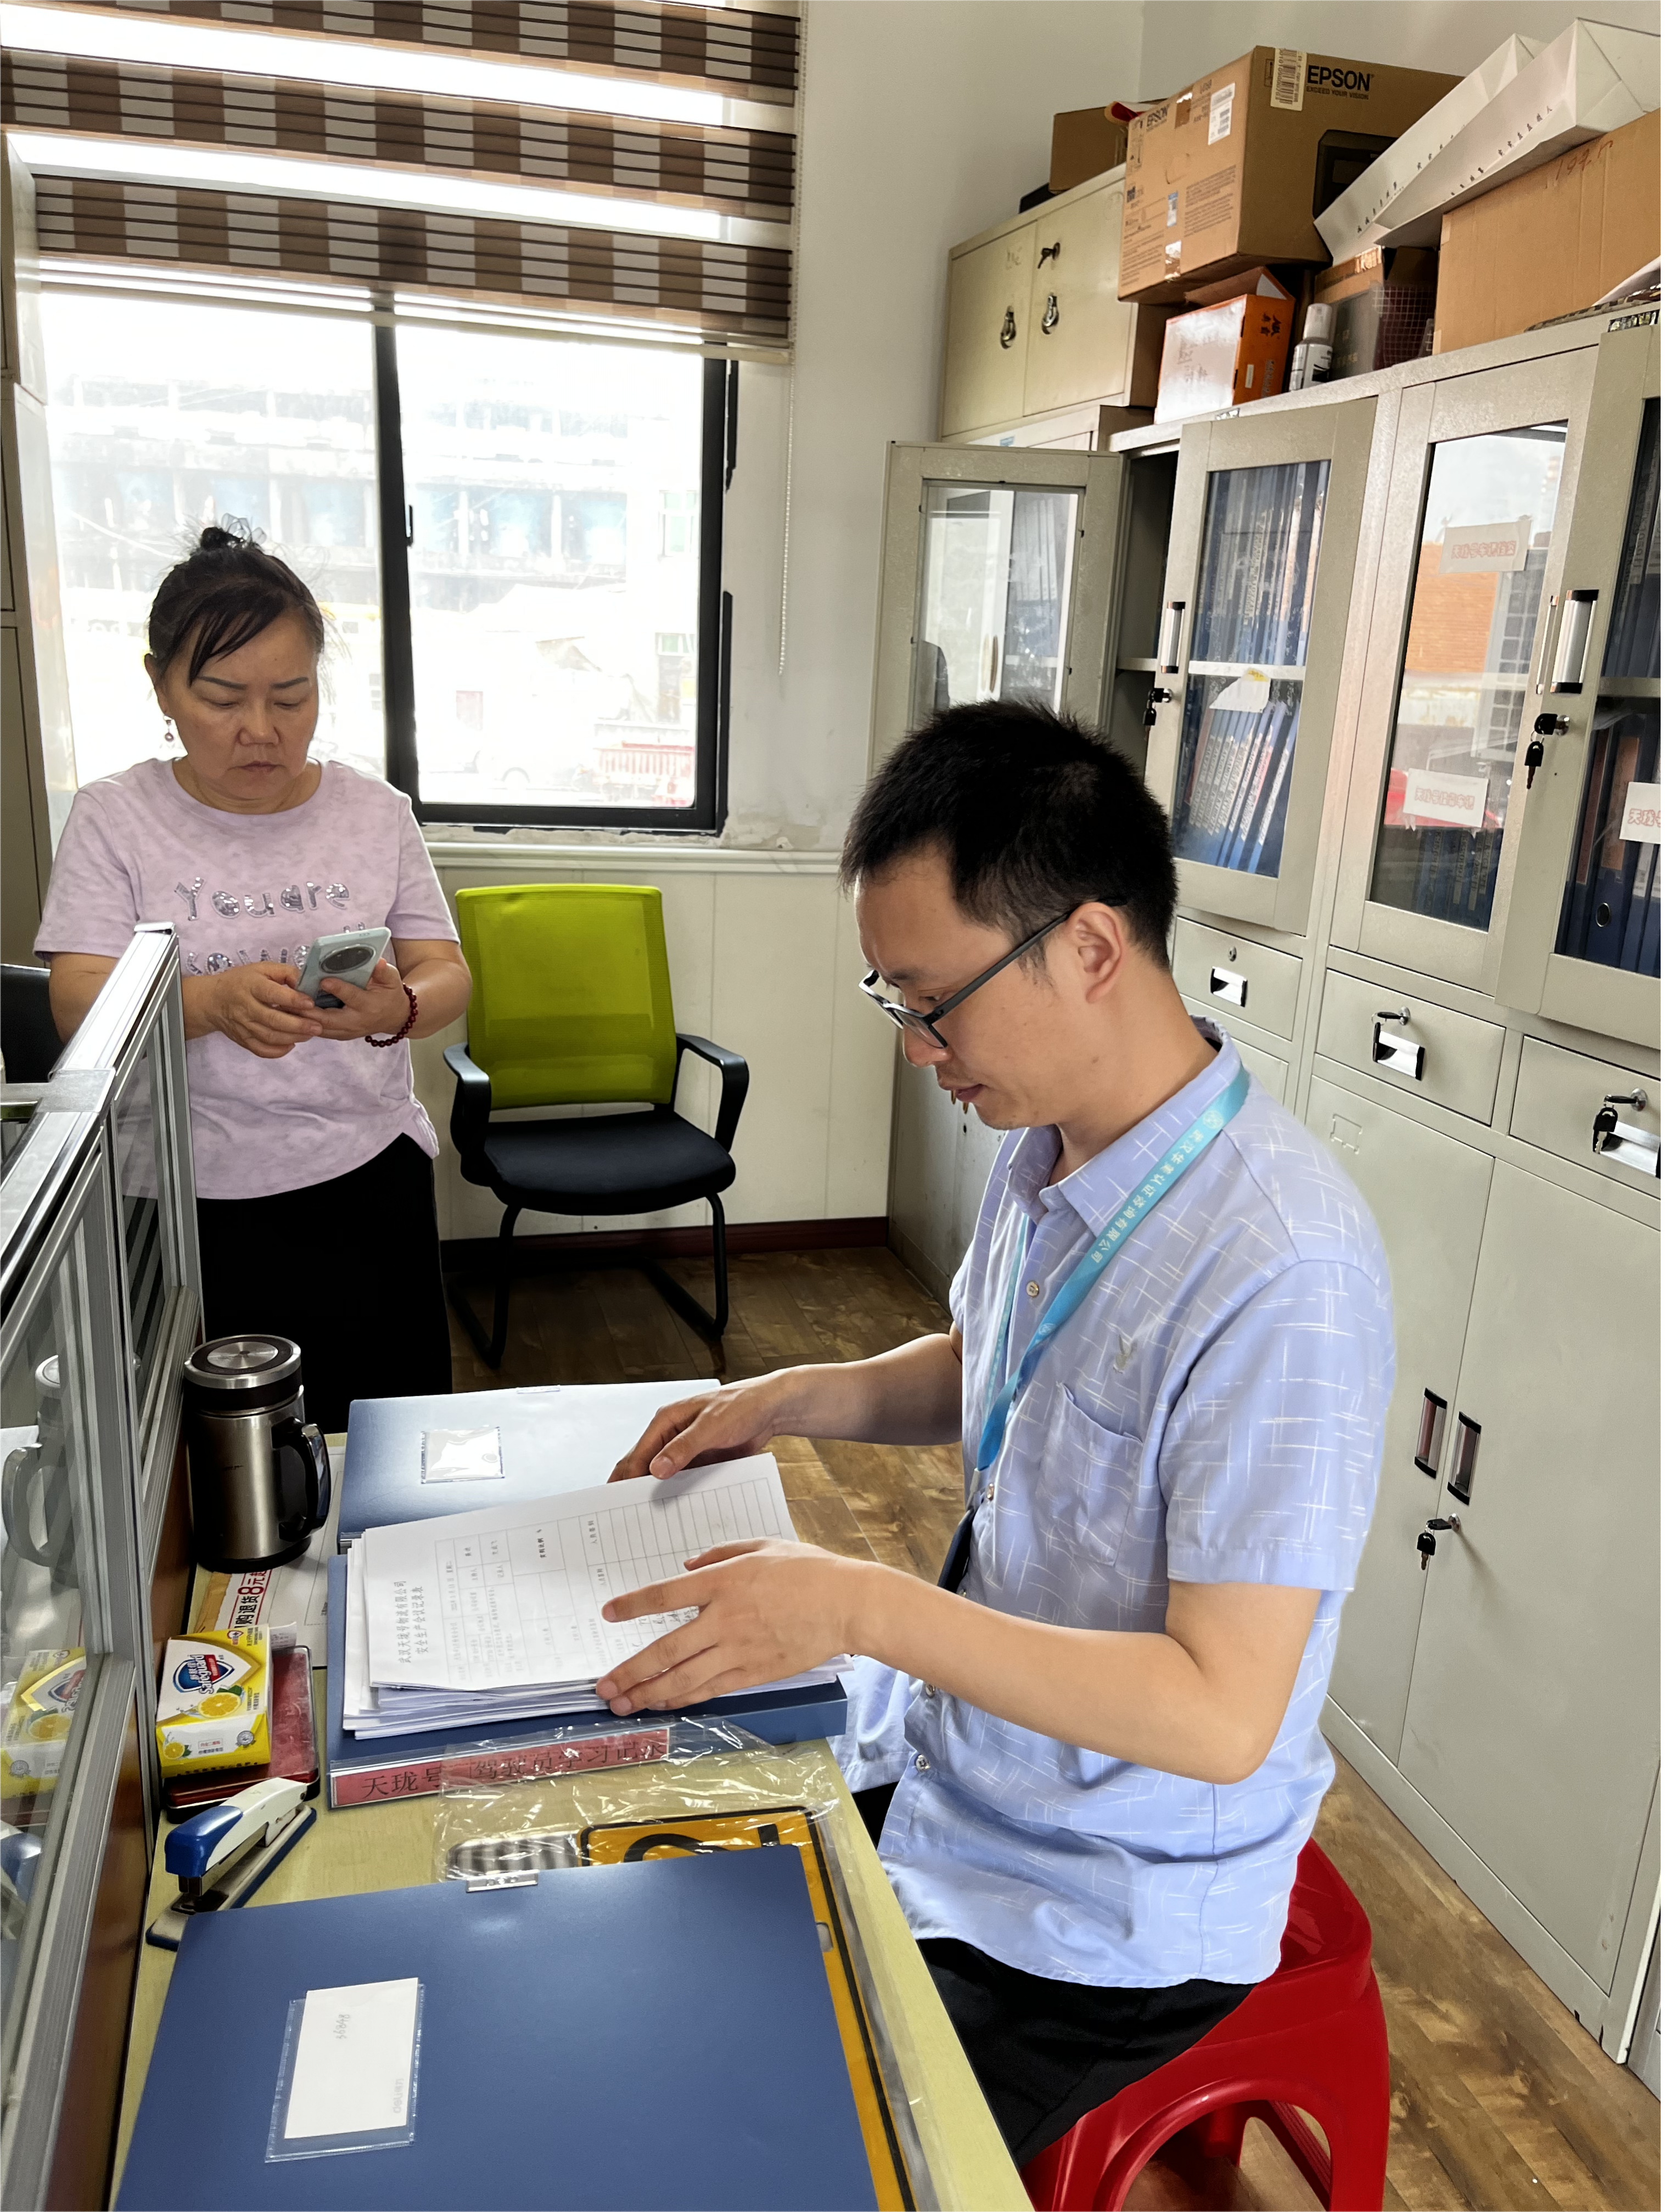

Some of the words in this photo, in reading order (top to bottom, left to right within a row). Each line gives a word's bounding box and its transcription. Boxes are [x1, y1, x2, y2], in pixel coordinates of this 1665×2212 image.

[1307, 65, 1371, 92] EPSON
[1307, 86, 1330, 95] EXCEED
[1331, 89, 1348, 98] YOUR
[174, 877, 276, 921] You
[280, 882, 350, 913] are
[587, 1520, 598, 1545] 人员签到
[234, 1569, 266, 1629] 购退货8元起
[394, 1581, 411, 1663] 武汉天珑号物流有限公司
[411, 1586, 429, 1654] 安全生产会议记录表
[189, 1654, 215, 1694] Safeguard
[362, 1767, 441, 1799] 天珑号
